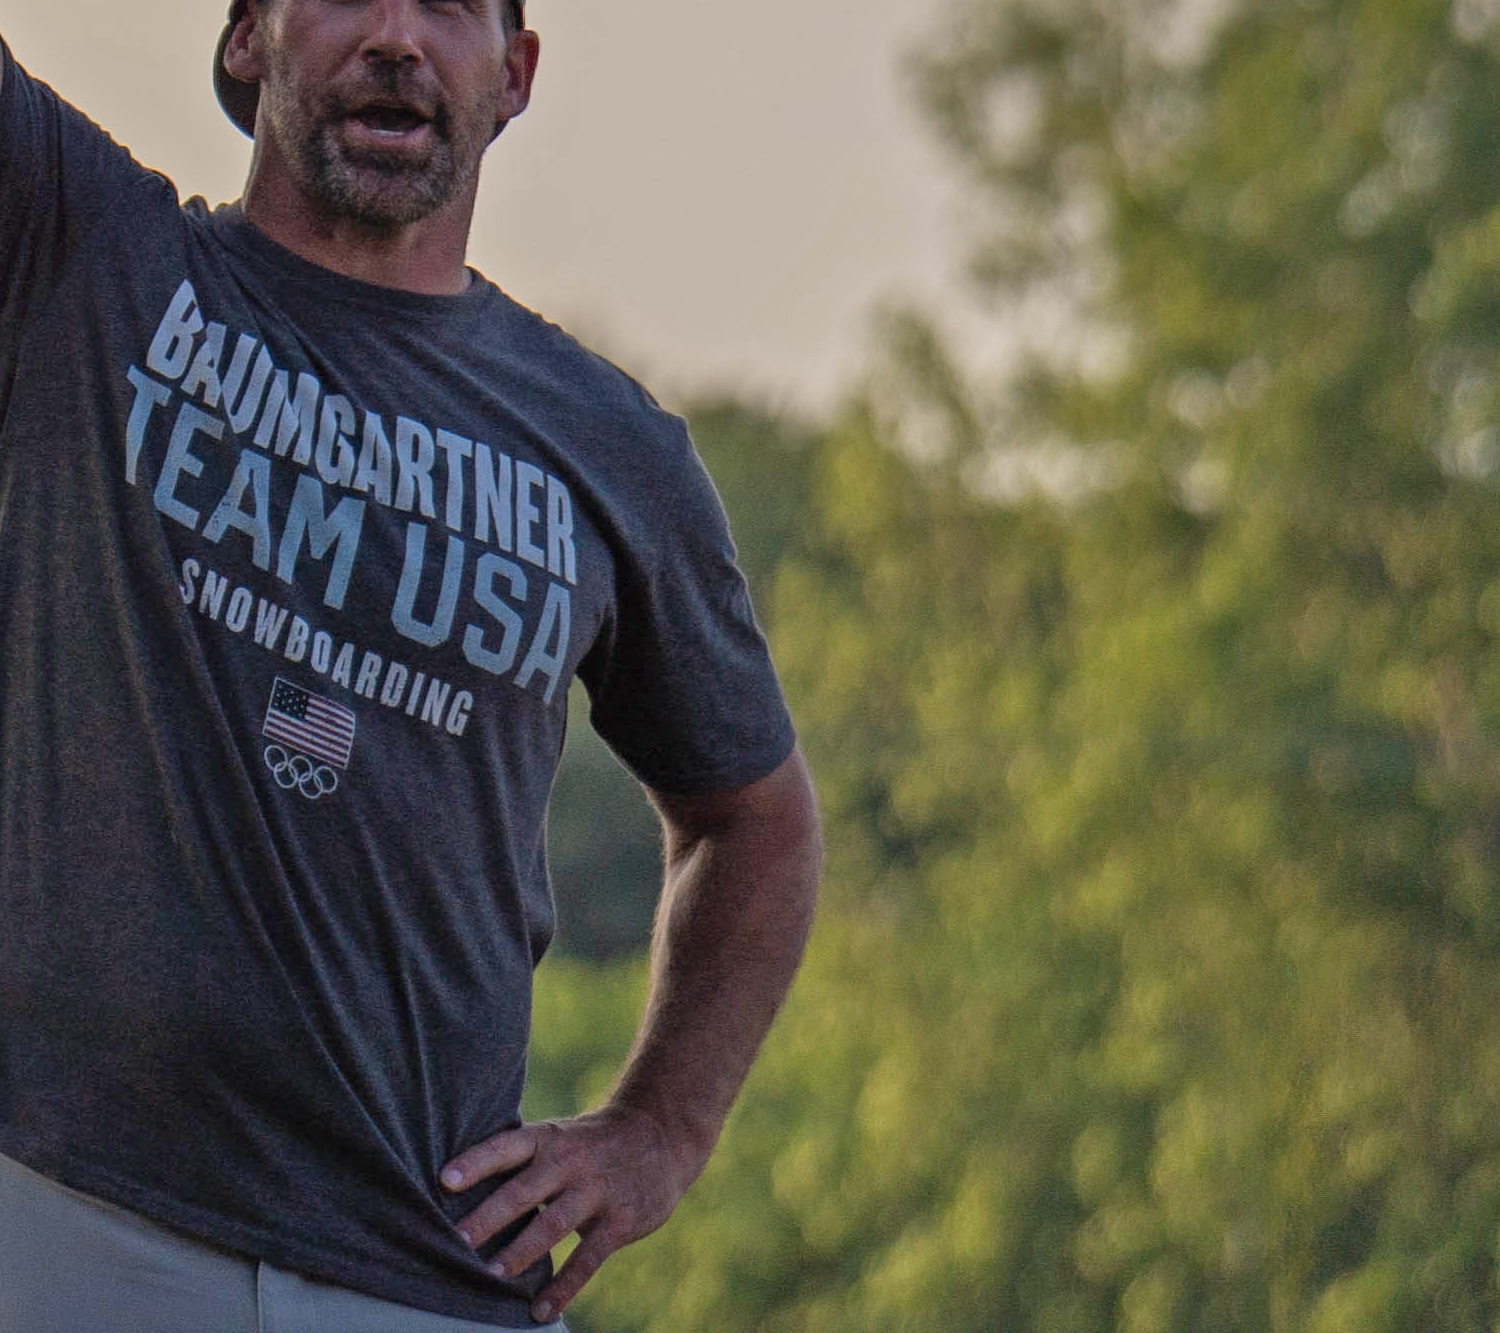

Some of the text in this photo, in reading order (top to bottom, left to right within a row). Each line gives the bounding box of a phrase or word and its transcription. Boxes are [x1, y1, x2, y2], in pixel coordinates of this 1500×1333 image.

[125, 365, 571, 703] TEAM USA
[146, 279, 577, 585] BAUMGARTNER
[180, 559, 473, 737] SNOWBOARDING
